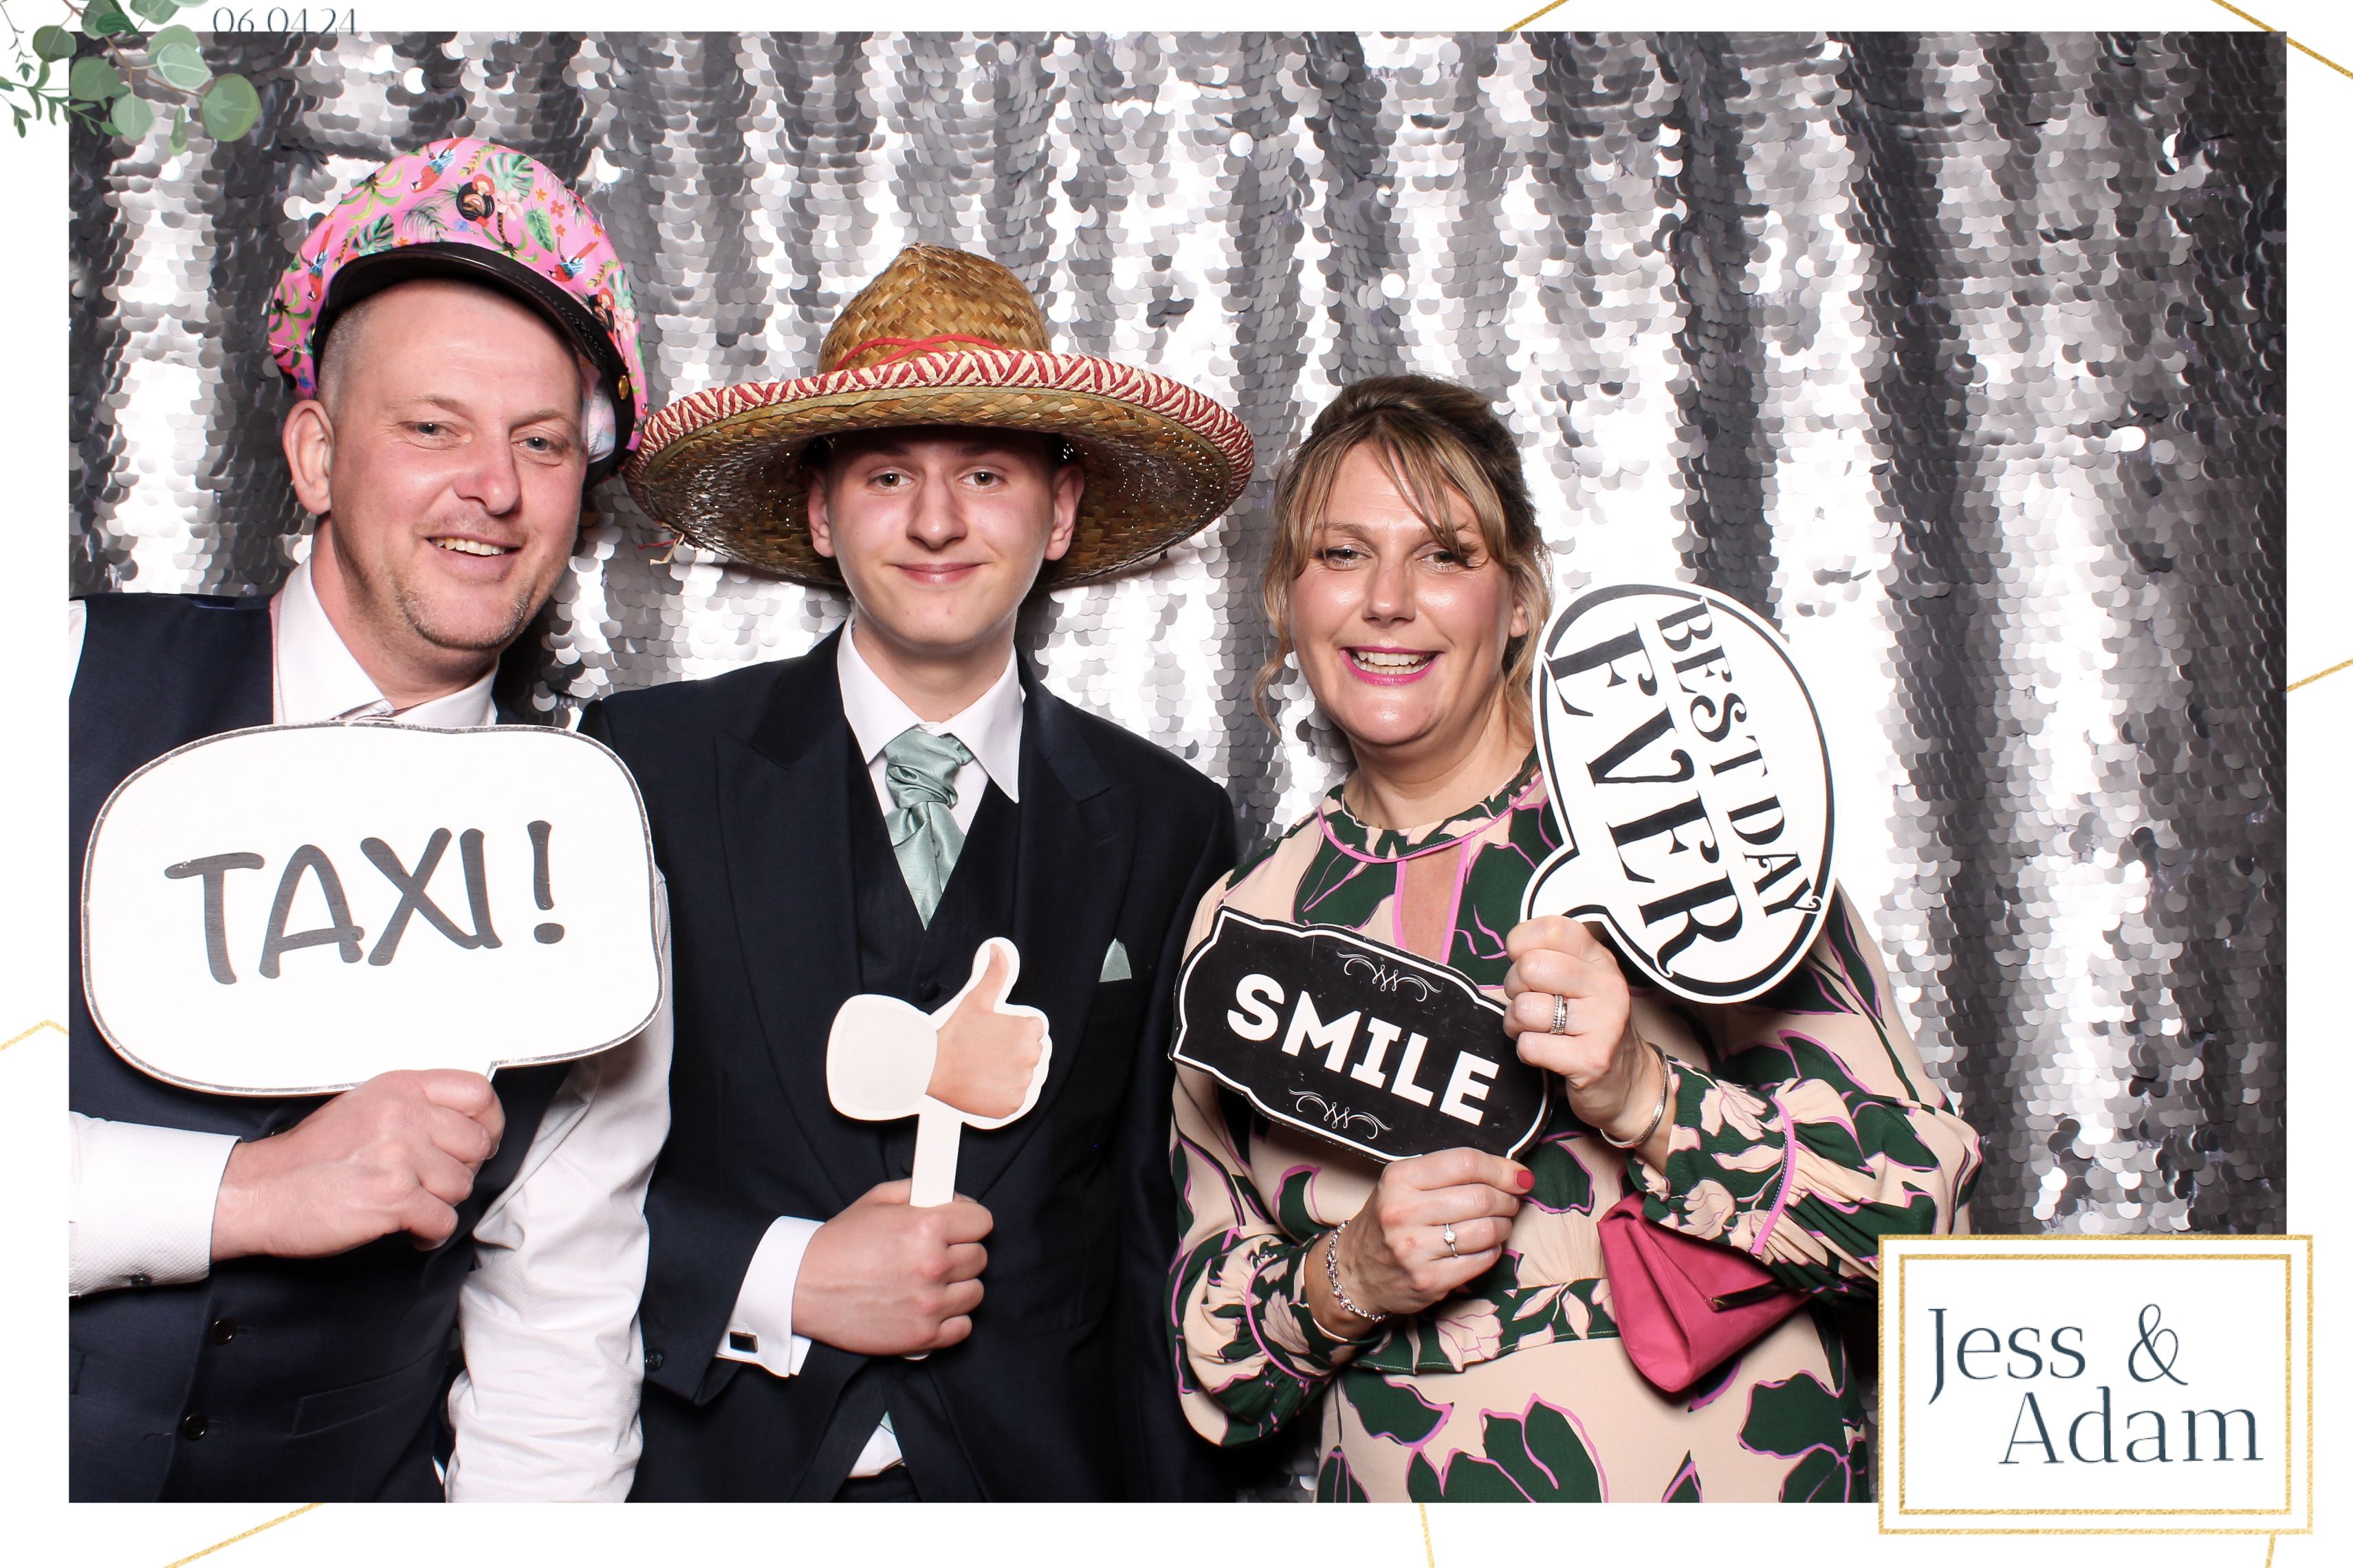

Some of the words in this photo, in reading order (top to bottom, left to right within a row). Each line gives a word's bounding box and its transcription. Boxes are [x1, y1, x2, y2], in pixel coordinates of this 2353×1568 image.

[1546, 621, 1743, 976] EVER
[1655, 599, 1767, 777] BEST
[1727, 794, 1822, 917] DAY
[164, 820, 565, 985] TAXI!
[1227, 973, 1500, 1126] SMILE
